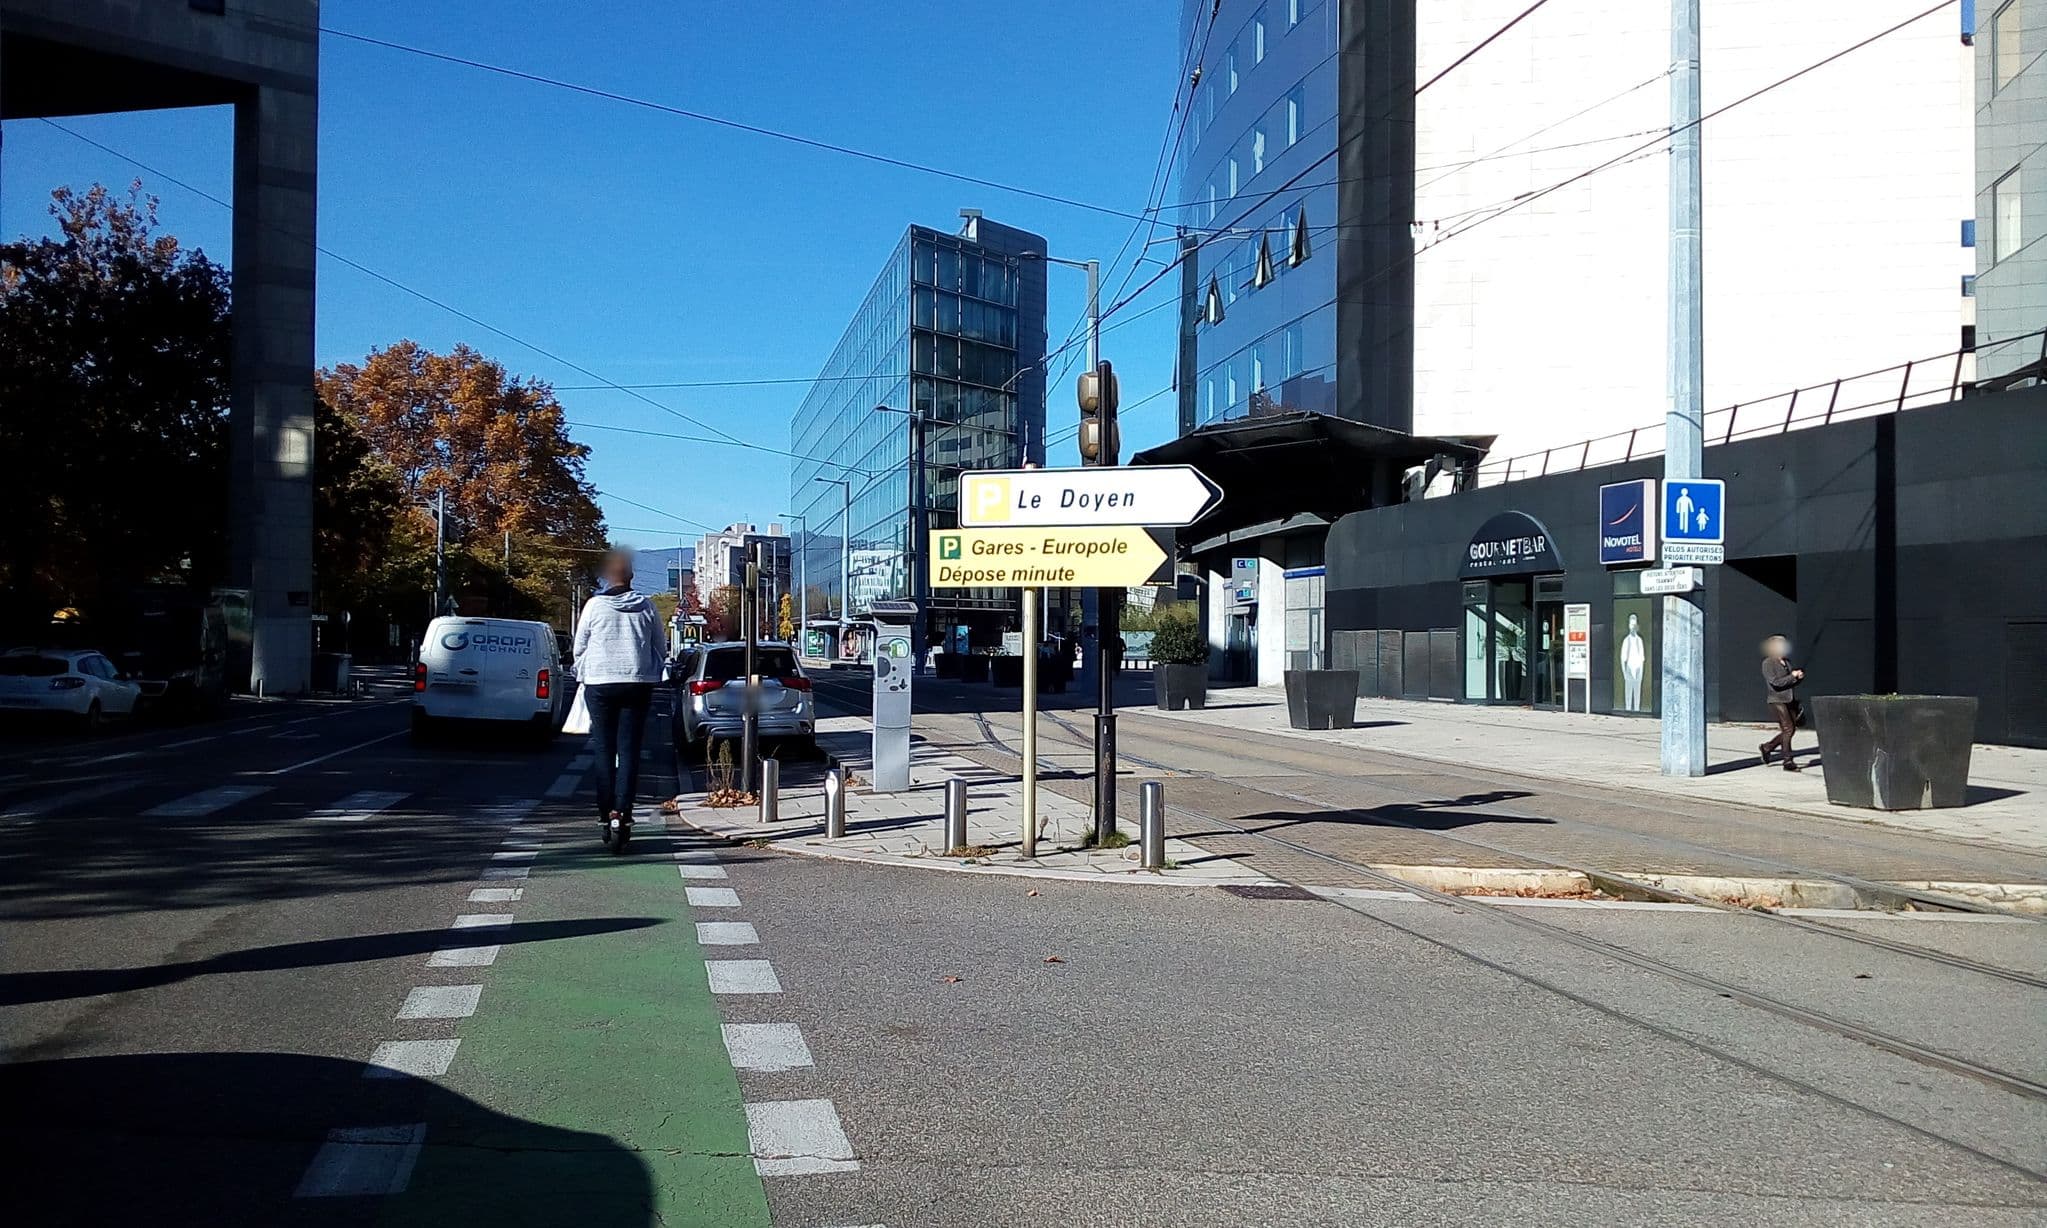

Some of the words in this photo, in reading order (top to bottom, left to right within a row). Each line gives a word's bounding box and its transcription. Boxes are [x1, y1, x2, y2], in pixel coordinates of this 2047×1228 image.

[1018, 490, 1042, 509] Le
[1060, 489, 1135, 512] Doyen
[971, 539, 1025, 556] Gares
[1042, 538, 1128, 558] Europole
[1603, 534, 1642, 548] NOVOTEL
[939, 566, 1007, 585] Dépose
[1011, 565, 1075, 582] minute
[473, 644, 531, 654] TECHNIC
